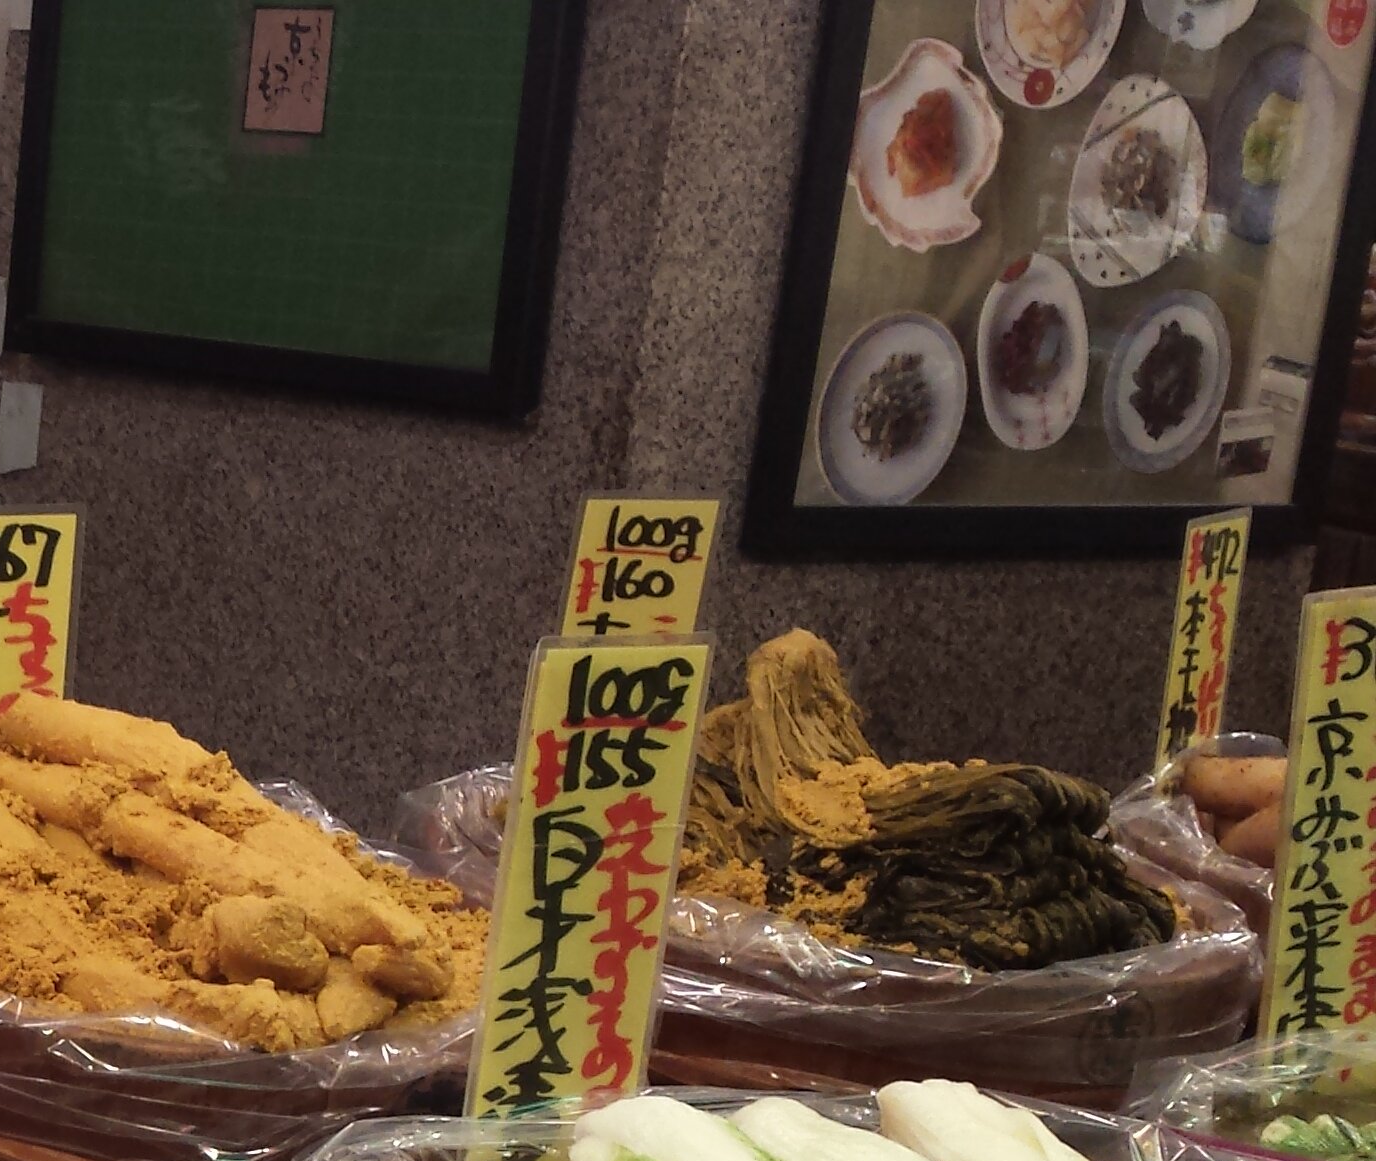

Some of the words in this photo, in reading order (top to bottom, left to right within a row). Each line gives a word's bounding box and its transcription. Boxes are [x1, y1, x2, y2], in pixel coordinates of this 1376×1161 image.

[606, 505, 703, 563] 100g
[575, 557, 675, 613] ¥160
[1321, 616, 1376, 686] ¥3
[565, 655, 694, 726] 100g
[532, 729, 670, 808] ¥155
